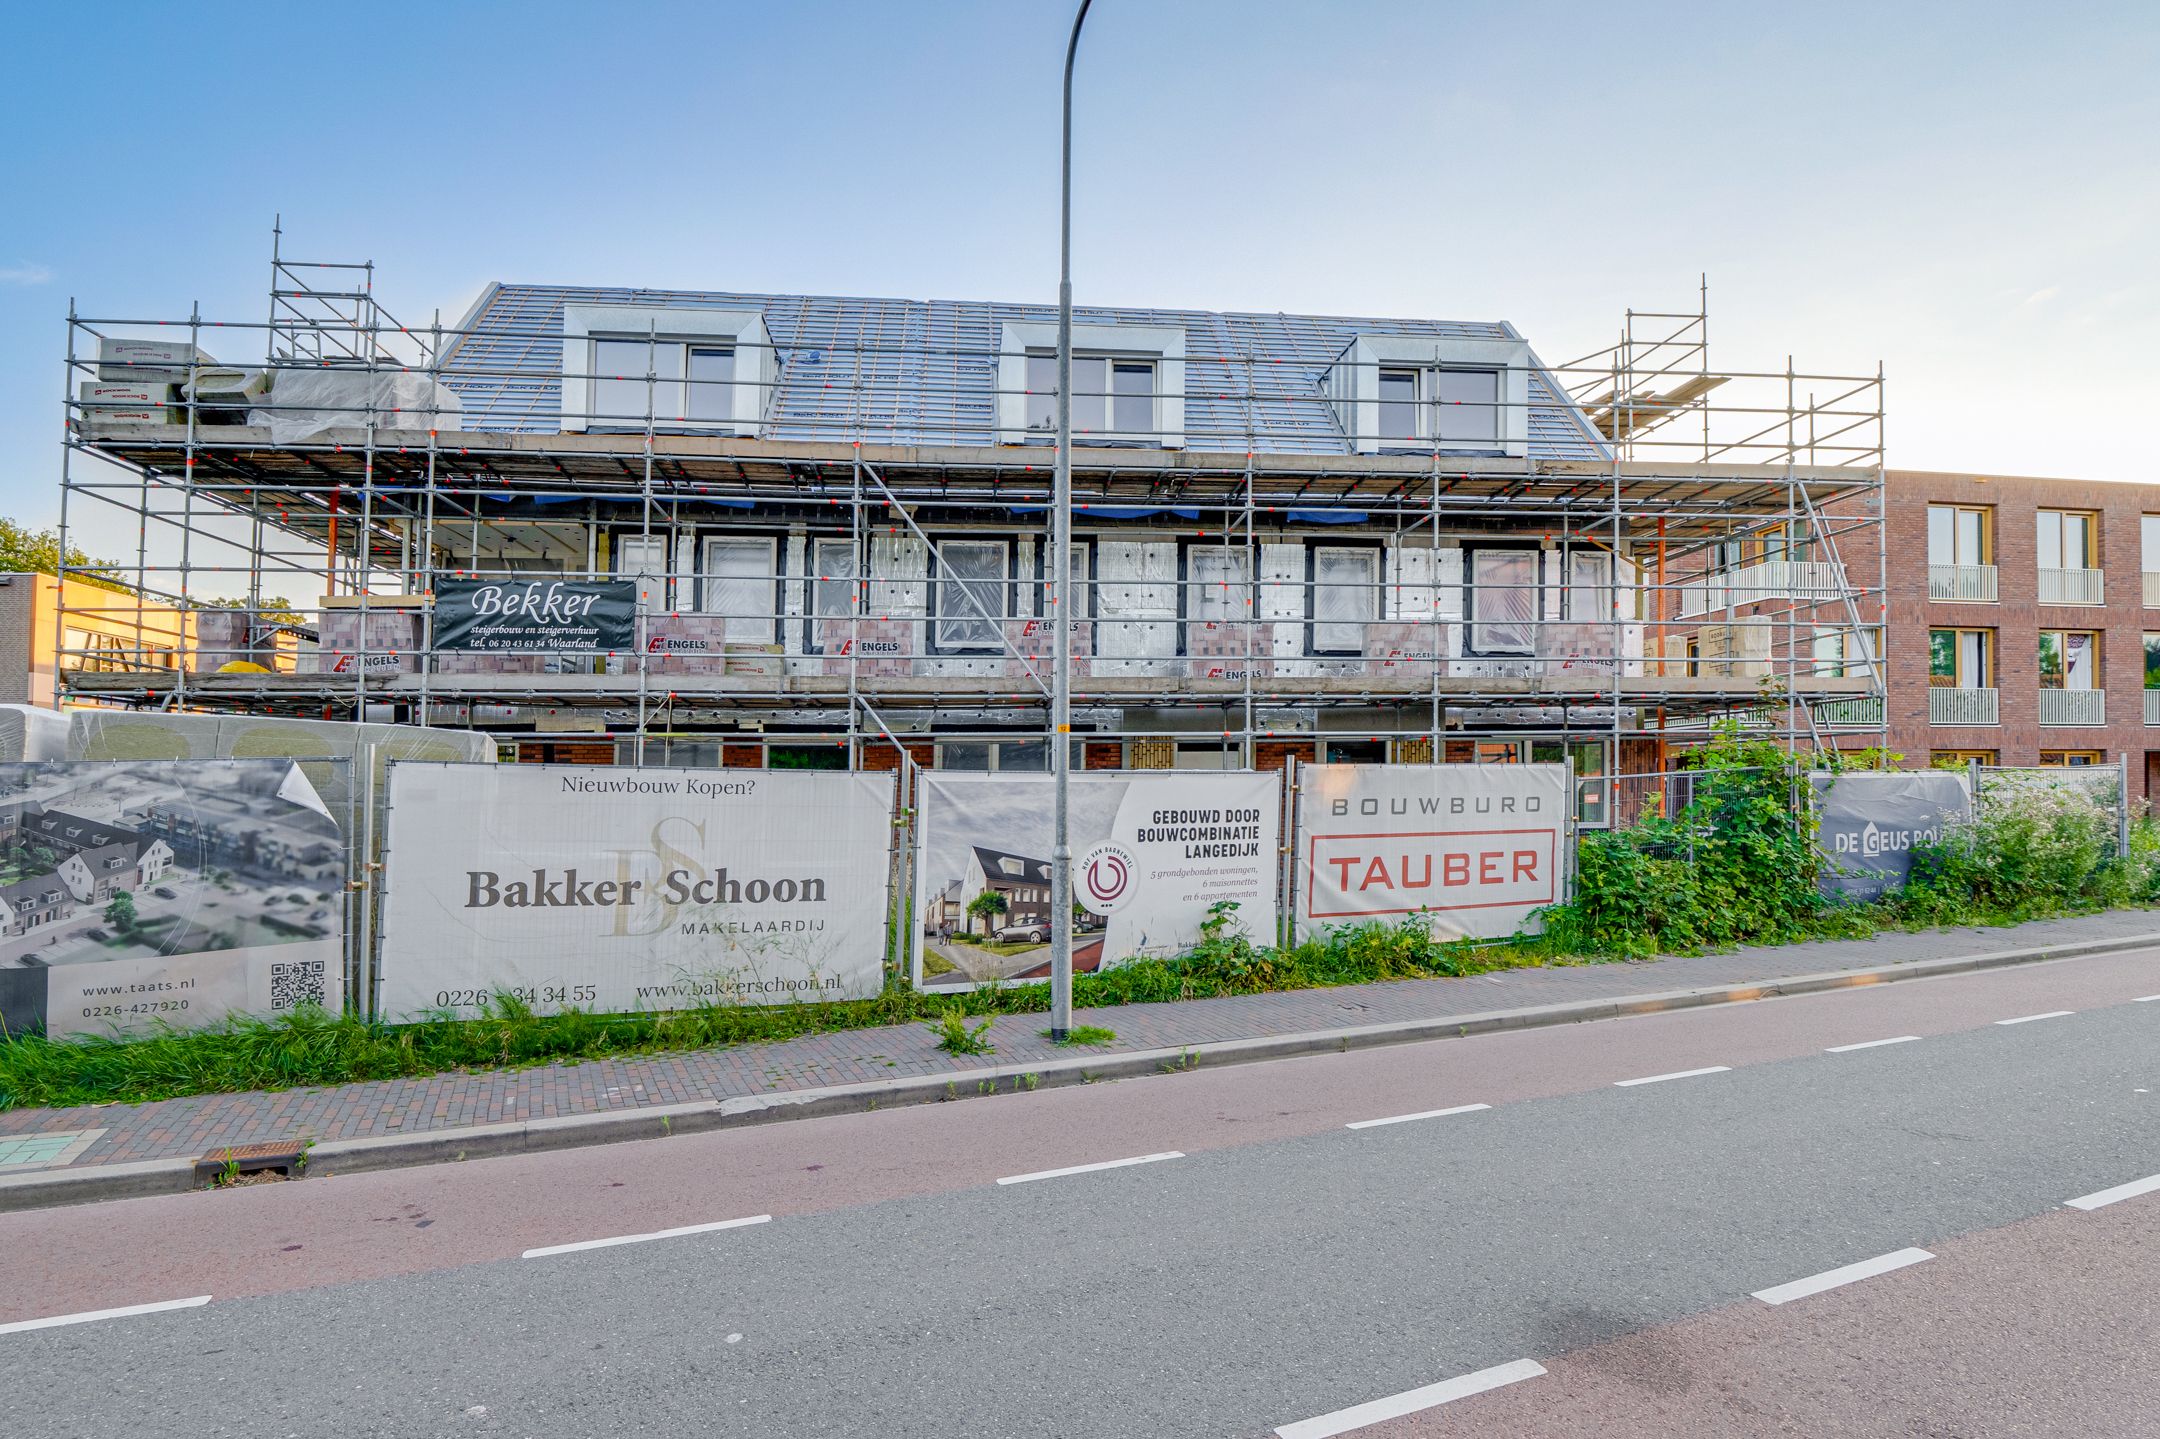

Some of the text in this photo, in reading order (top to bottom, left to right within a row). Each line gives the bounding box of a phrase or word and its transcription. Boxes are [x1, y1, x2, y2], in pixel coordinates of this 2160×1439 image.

[471, 581, 600, 624] Bekker
[470, 625, 524, 636] steigerbouw
[537, 625, 599, 636] steigerverhuur
[489, 640, 499, 648] 06
[501, 640, 511, 648] 20
[512, 640, 523, 648] 43
[524, 640, 534, 648] 61
[535, 640, 545, 648] 34
[547, 637, 598, 648] Waarland
[667, 640, 706, 649] ENGELS
[861, 642, 898, 652] ENGELS
[1225, 670, 1262, 680] ENGLS
[561, 776, 756, 799] Nieuwbouw Kopen?
[1331, 796, 1541, 816] BOUWBURO
[1152, 809, 1260, 825] GEBOUWD DOOR
[1137, 826, 1260, 843] BOUWCOMBINATIE
[1835, 832, 1858, 853] DE
[1863, 829, 1909, 852] GEUS
[1185, 843, 1259, 859] LANGEDIJK
[1150, 866, 1258, 880] 5 grondgebonden woningen,
[1328, 850, 1539, 892] TAUBER
[464, 867, 827, 908] Bakker Schoon
[1202, 878, 1258, 888] 6 maisonnettes
[1182, 890, 1258, 902] en 6 appartementen
[681, 919, 826, 936] MAKELAARDIJ
[82, 978, 195, 996] www.taats.nl
[436, 984, 596, 1008] 0226 34 34 55
[82, 1000, 189, 1018] 0226-427920
